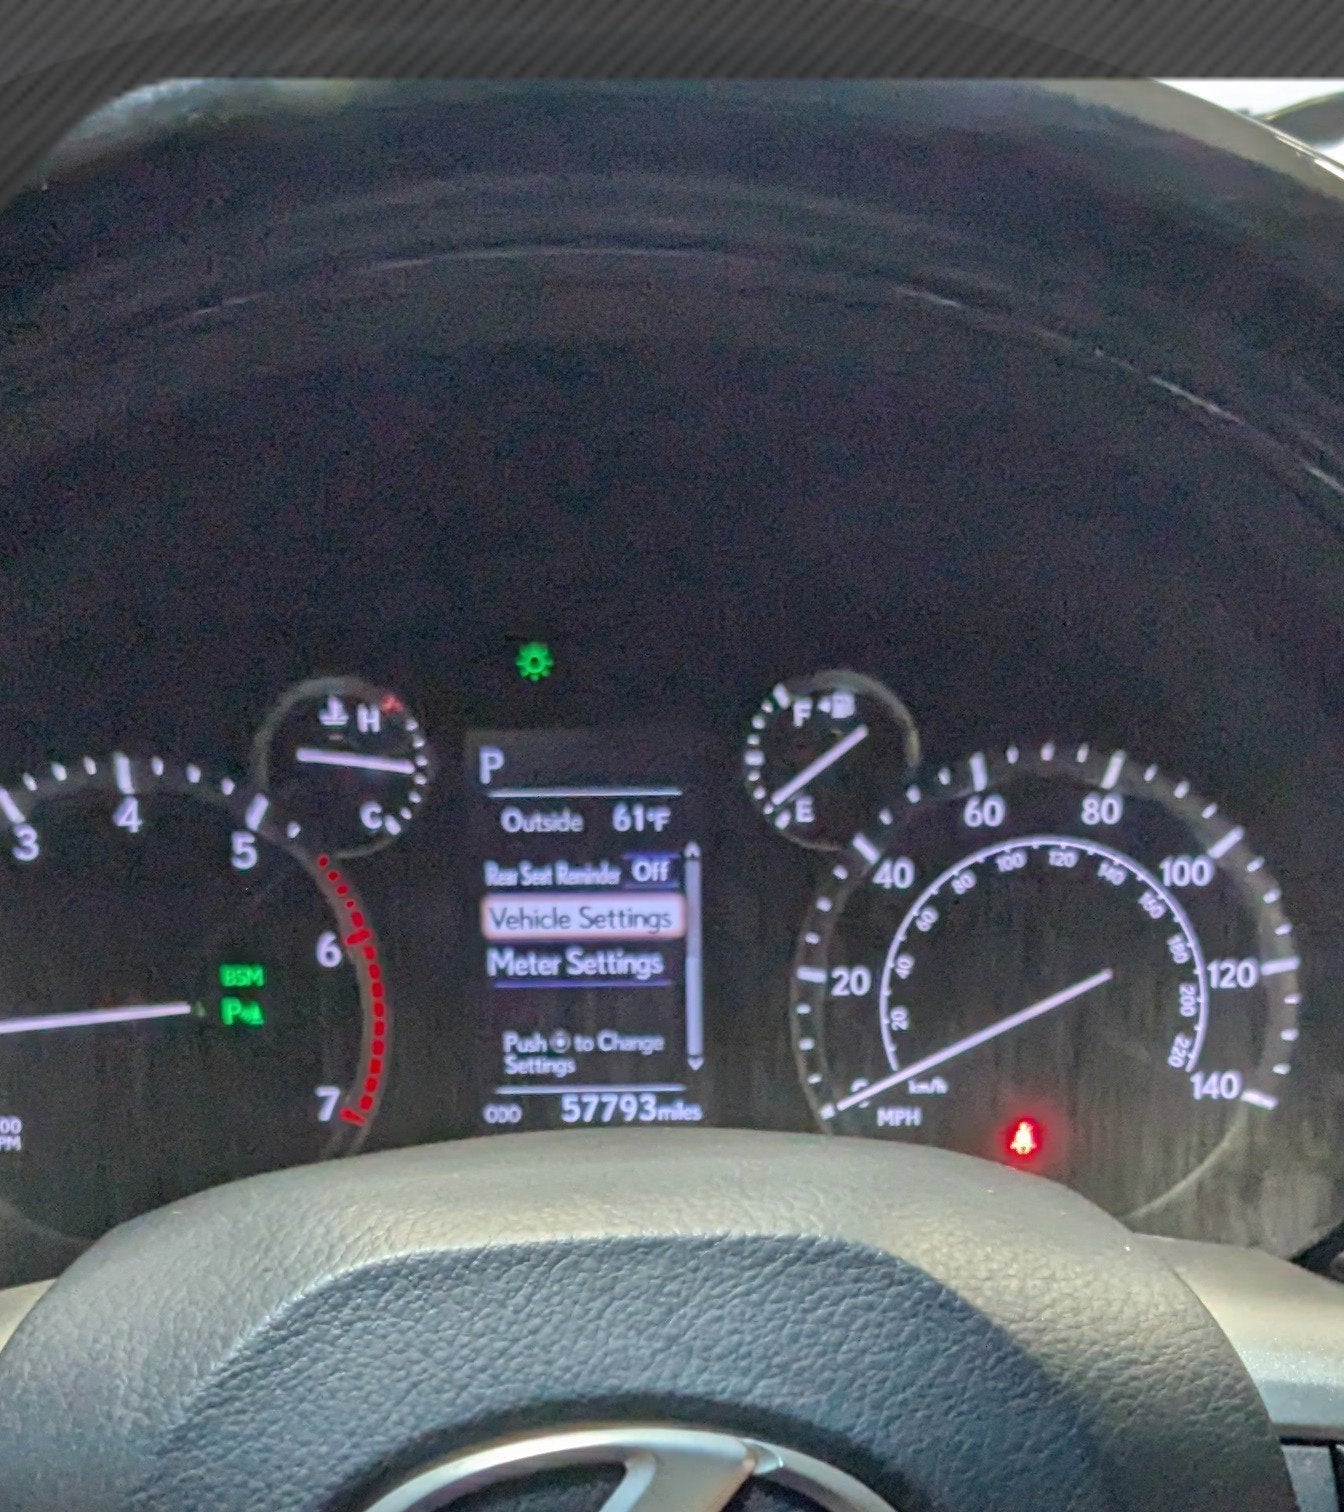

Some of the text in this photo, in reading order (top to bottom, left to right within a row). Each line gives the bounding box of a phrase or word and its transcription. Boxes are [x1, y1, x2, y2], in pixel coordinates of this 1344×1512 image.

[357, 708, 380, 733] H
[792, 701, 813, 727] F
[479, 746, 505, 785] P
[115, 797, 143, 833] 4
[360, 802, 384, 831] C
[500, 806, 584, 833] Outside
[795, 799, 815, 823] E
[963, 795, 1006, 828] 60
[1081, 795, 1122, 826] 80
[13, 826, 40, 861] 3
[232, 833, 258, 870] 5
[554, 860, 622, 886] Reminder
[632, 857, 670, 882] Off
[873, 856, 915, 889] 40
[1160, 855, 1214, 888] 100
[489, 905, 673, 935] Vehicle Settings
[316, 932, 343, 968] 6
[486, 946, 665, 981] Meter Settings
[831, 966, 870, 997] 20
[1208, 959, 1256, 989] 120
[503, 1029, 665, 1056] Push to Change
[503, 1053, 577, 1078] Settings
[1189, 1069, 1242, 1101] 140
[315, 1086, 342, 1122] 7
[561, 1092, 656, 1123] 57793
[877, 1107, 922, 1127] MPH
